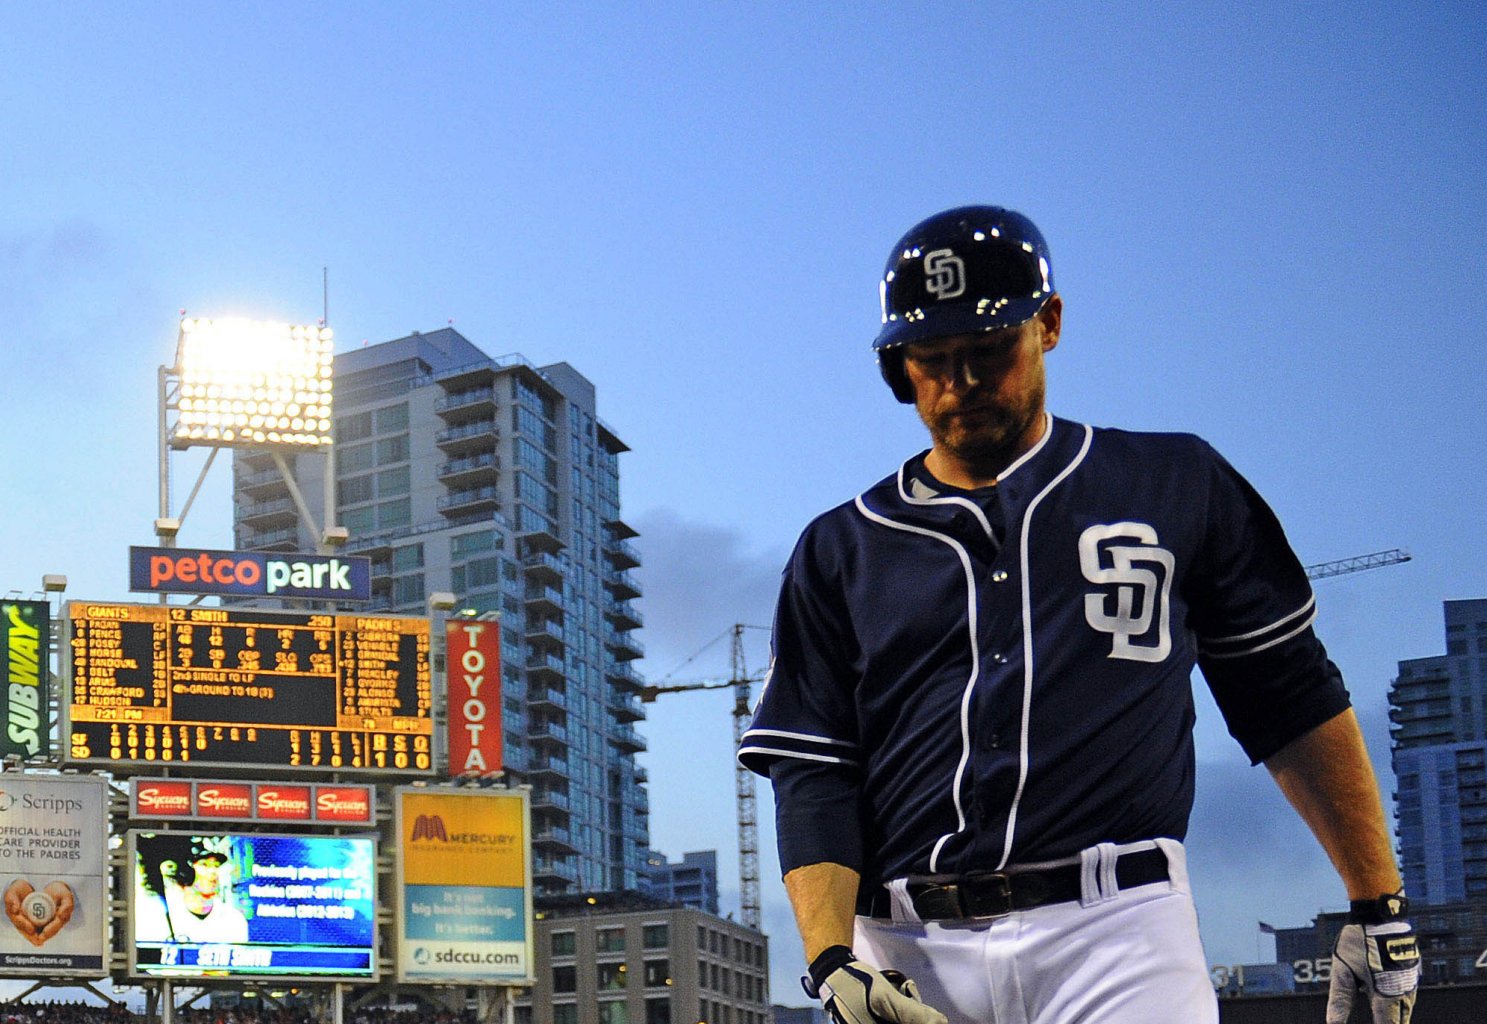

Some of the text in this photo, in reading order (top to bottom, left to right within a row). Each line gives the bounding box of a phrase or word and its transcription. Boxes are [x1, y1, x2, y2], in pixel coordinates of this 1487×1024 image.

[924, 249, 966, 300] SD
[150, 553, 351, 594] petco park
[1078, 521, 1175, 663] SD
[87, 606, 128, 618] GIANTS
[191, 610, 228, 622] SMITH
[7, 604, 40, 756] SUBWAY
[462, 626, 487, 771] TOYOTA
[110, 736, 121, 747] 0
[128, 736, 138, 748] 0
[145, 737, 155, 748] 0
[162, 738, 172, 749] 0
[196, 738, 207, 750] 0
[71, 746, 91, 758] SD
[110, 747, 121, 760] 0
[129, 748, 138, 760] 1
[145, 748, 156, 760] 0
[162, 749, 173, 761] 0
[180, 749, 189, 761] 1
[375, 752, 429, 769] 1 0 0
[22, 793, 83, 814] Scripps
[138, 788, 189, 809] Sycuan
[198, 790, 249, 810] Sycuan
[258, 792, 309, 812] Sycuan
[317, 793, 368, 814] Sycuan
[43, 828, 81, 837] HEALTH
[450, 833, 517, 845] MERCURY
[29, 838, 81, 849] PROVIDER
[16, 849, 35, 858] THE
[40, 850, 81, 860] PADRES
[435, 949, 519, 964] sdccu.com
